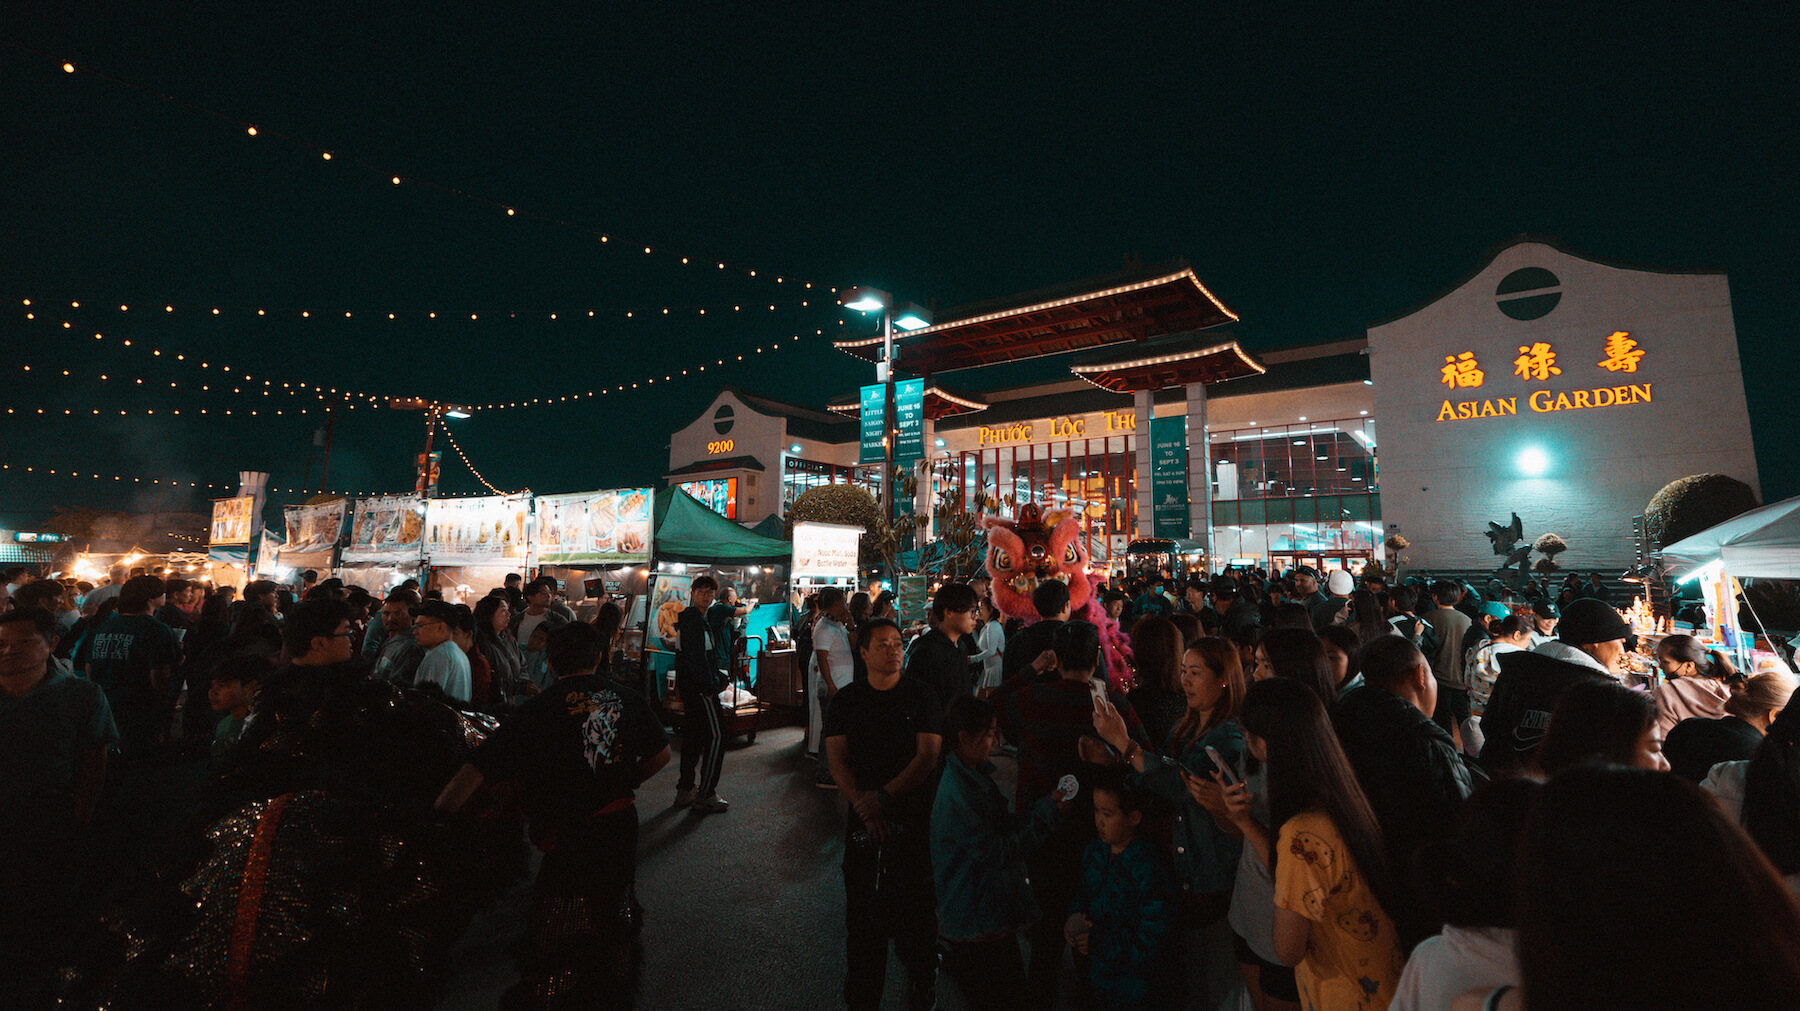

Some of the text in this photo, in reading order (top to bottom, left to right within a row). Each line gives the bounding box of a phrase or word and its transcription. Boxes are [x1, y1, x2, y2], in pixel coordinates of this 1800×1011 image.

[1440, 351, 1485, 390] 福
[1597, 331, 1647, 374] 壽
[1436, 383, 1652, 421] ASIAN GARDEN
[707, 439, 734, 455] 9200
